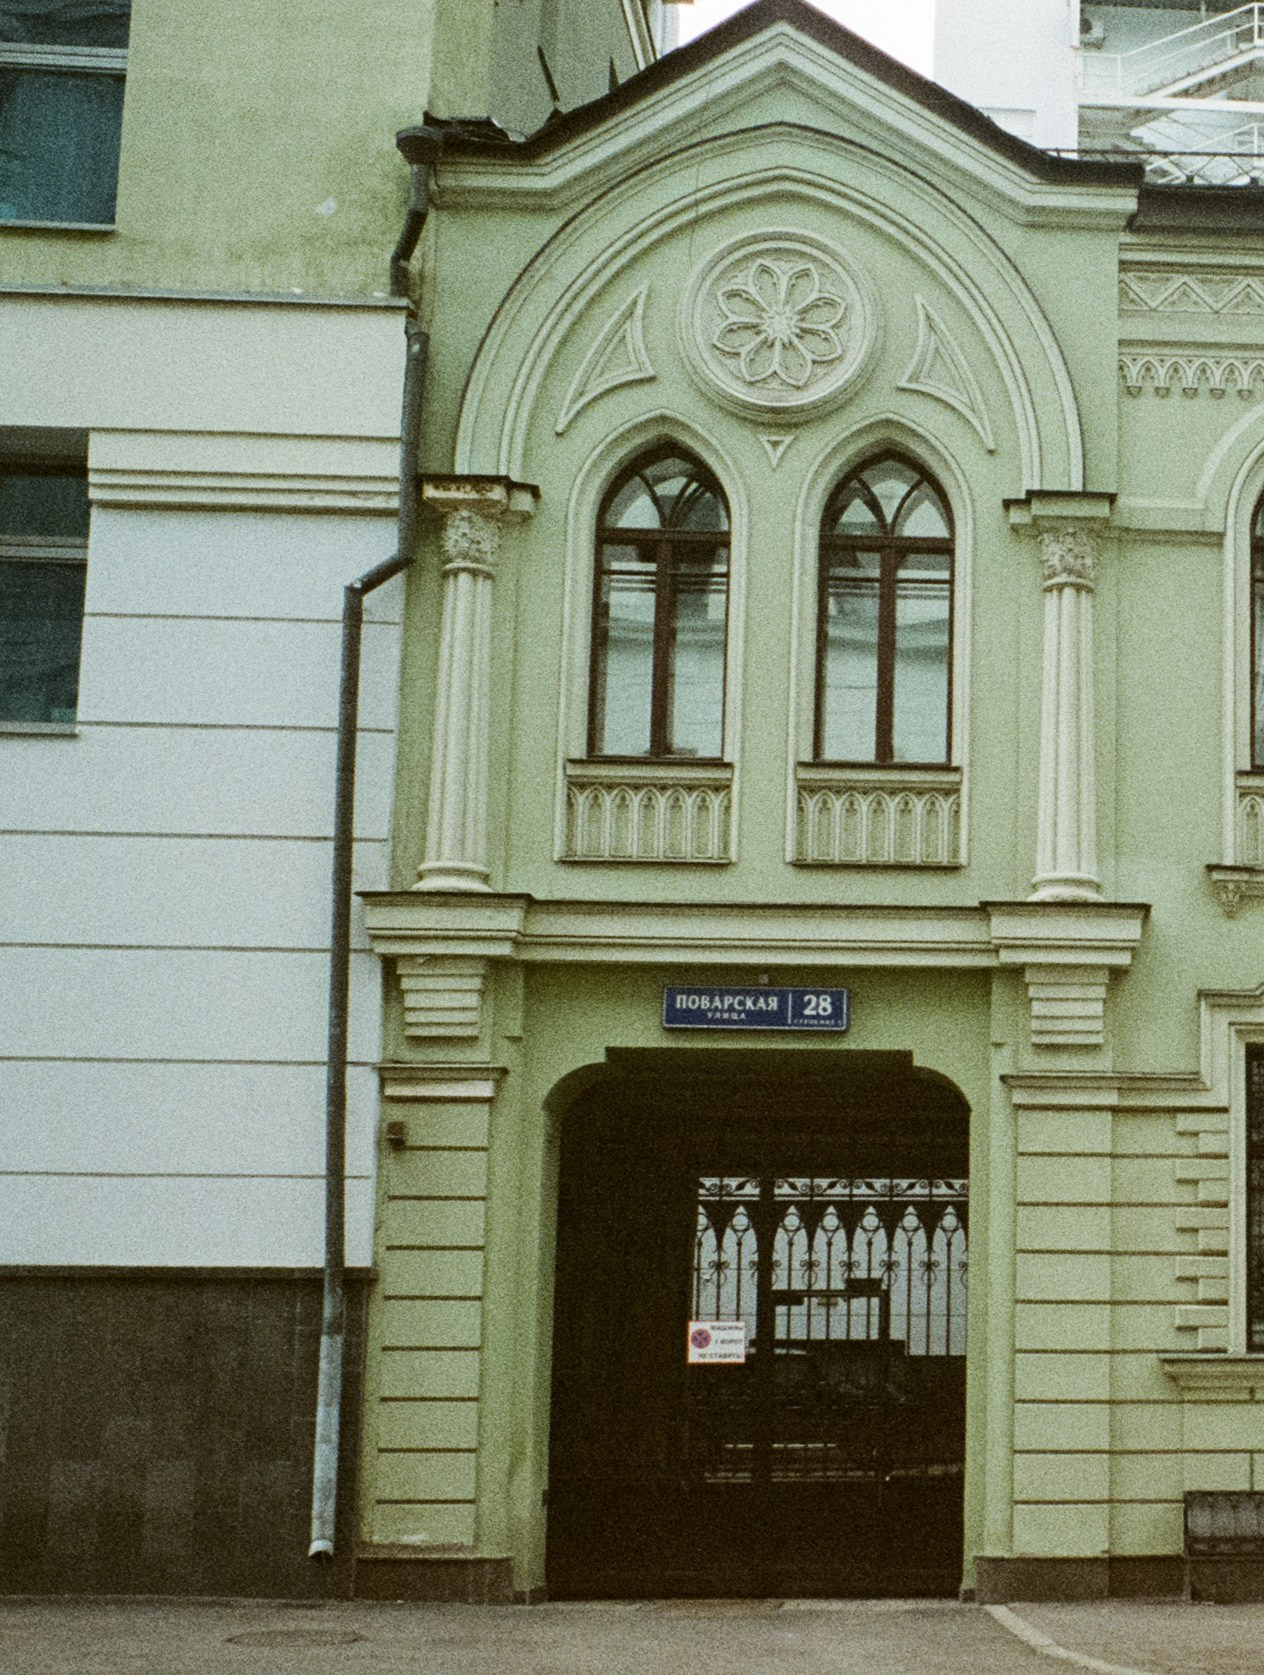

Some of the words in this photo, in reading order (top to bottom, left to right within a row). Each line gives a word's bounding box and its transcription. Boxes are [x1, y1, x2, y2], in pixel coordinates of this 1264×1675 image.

[675, 994, 779, 1011] ПОВАРСКАЯ
[802, 994, 833, 1017] 28
[707, 1011, 747, 1020] УЛИЦА
